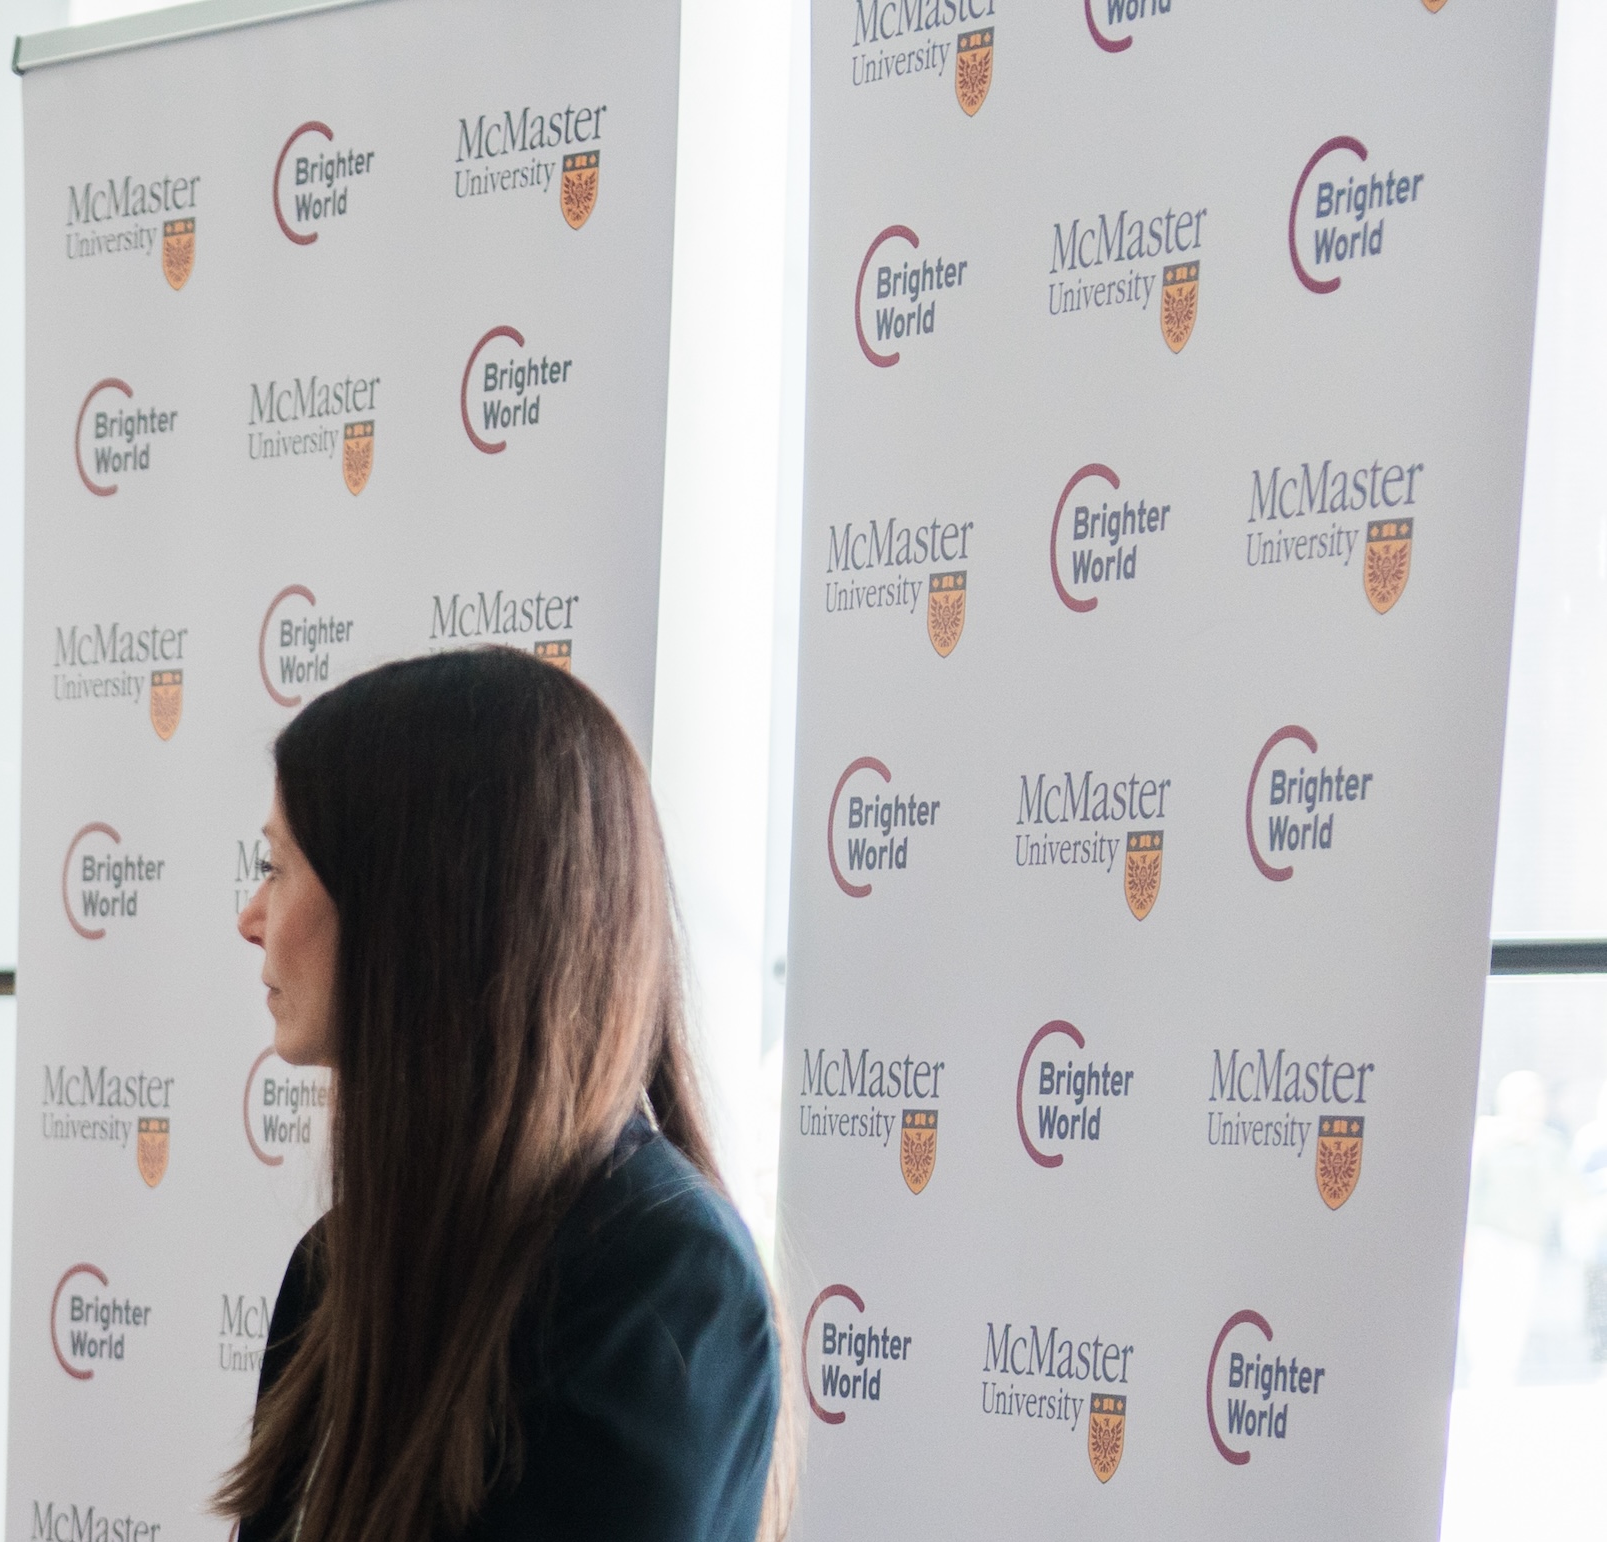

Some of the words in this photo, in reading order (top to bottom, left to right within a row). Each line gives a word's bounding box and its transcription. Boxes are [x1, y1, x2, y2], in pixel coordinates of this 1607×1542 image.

[851, 39, 950, 88] University
[455, 104, 607, 163] McMaster
[295, 149, 374, 188] Brighter
[454, 158, 556, 199] University
[66, 172, 201, 227] McMaster
[295, 187, 348, 223] World
[1315, 170, 1425, 219] Brighter
[65, 224, 158, 261] University
[1049, 208, 1208, 275] McMaster
[1314, 219, 1385, 266] World
[876, 258, 968, 301] Brighter
[1048, 271, 1156, 317] University
[875, 301, 936, 341] World
[484, 355, 572, 396] Brighter
[249, 374, 380, 426] McMaster
[483, 396, 541, 431] World
[94, 407, 178, 442] Brighter
[248, 424, 340, 462] University
[94, 443, 150, 474] World
[1248, 459, 1425, 524] McMaster
[1073, 500, 1171, 544] Brighter
[826, 517, 974, 574] McMaster
[1072, 546, 1138, 586] World
[1246, 522, 1359, 569] University
[429, 589, 580, 639] McMaster
[825, 575, 923, 614] University
[55, 623, 189, 668] McMaster
[280, 616, 354, 652] Brighter
[53, 670, 146, 702] University
[280, 651, 330, 685] World
[1016, 771, 1171, 826] McMaster
[1269, 766, 1373, 808] Brighter
[848, 794, 940, 836] Brighter
[1268, 813, 1335, 853] World
[81, 855, 165, 888] Brighter
[848, 838, 908, 871] World
[1015, 830, 1120, 874] University
[81, 889, 138, 918] World
[43, 1065, 175, 1110] McMaster
[801, 1049, 945, 1099] McMaster
[1039, 1060, 1134, 1102] Brighter
[1208, 1049, 1375, 1105] McMaster
[42, 1113, 132, 1148] University
[262, 1113, 311, 1144] World
[799, 1105, 896, 1148] University
[1038, 1105, 1101, 1142] World
[1207, 1112, 1311, 1158] University
[70, 1295, 152, 1328] Brighter
[70, 1330, 125, 1362] World
[822, 1322, 912, 1364] Brighter
[983, 1322, 1134, 1384] McMaster
[822, 1366, 881, 1401] World
[1229, 1352, 1325, 1398] Brighter
[981, 1382, 1084, 1432] University
[1227, 1399, 1288, 1440] World
